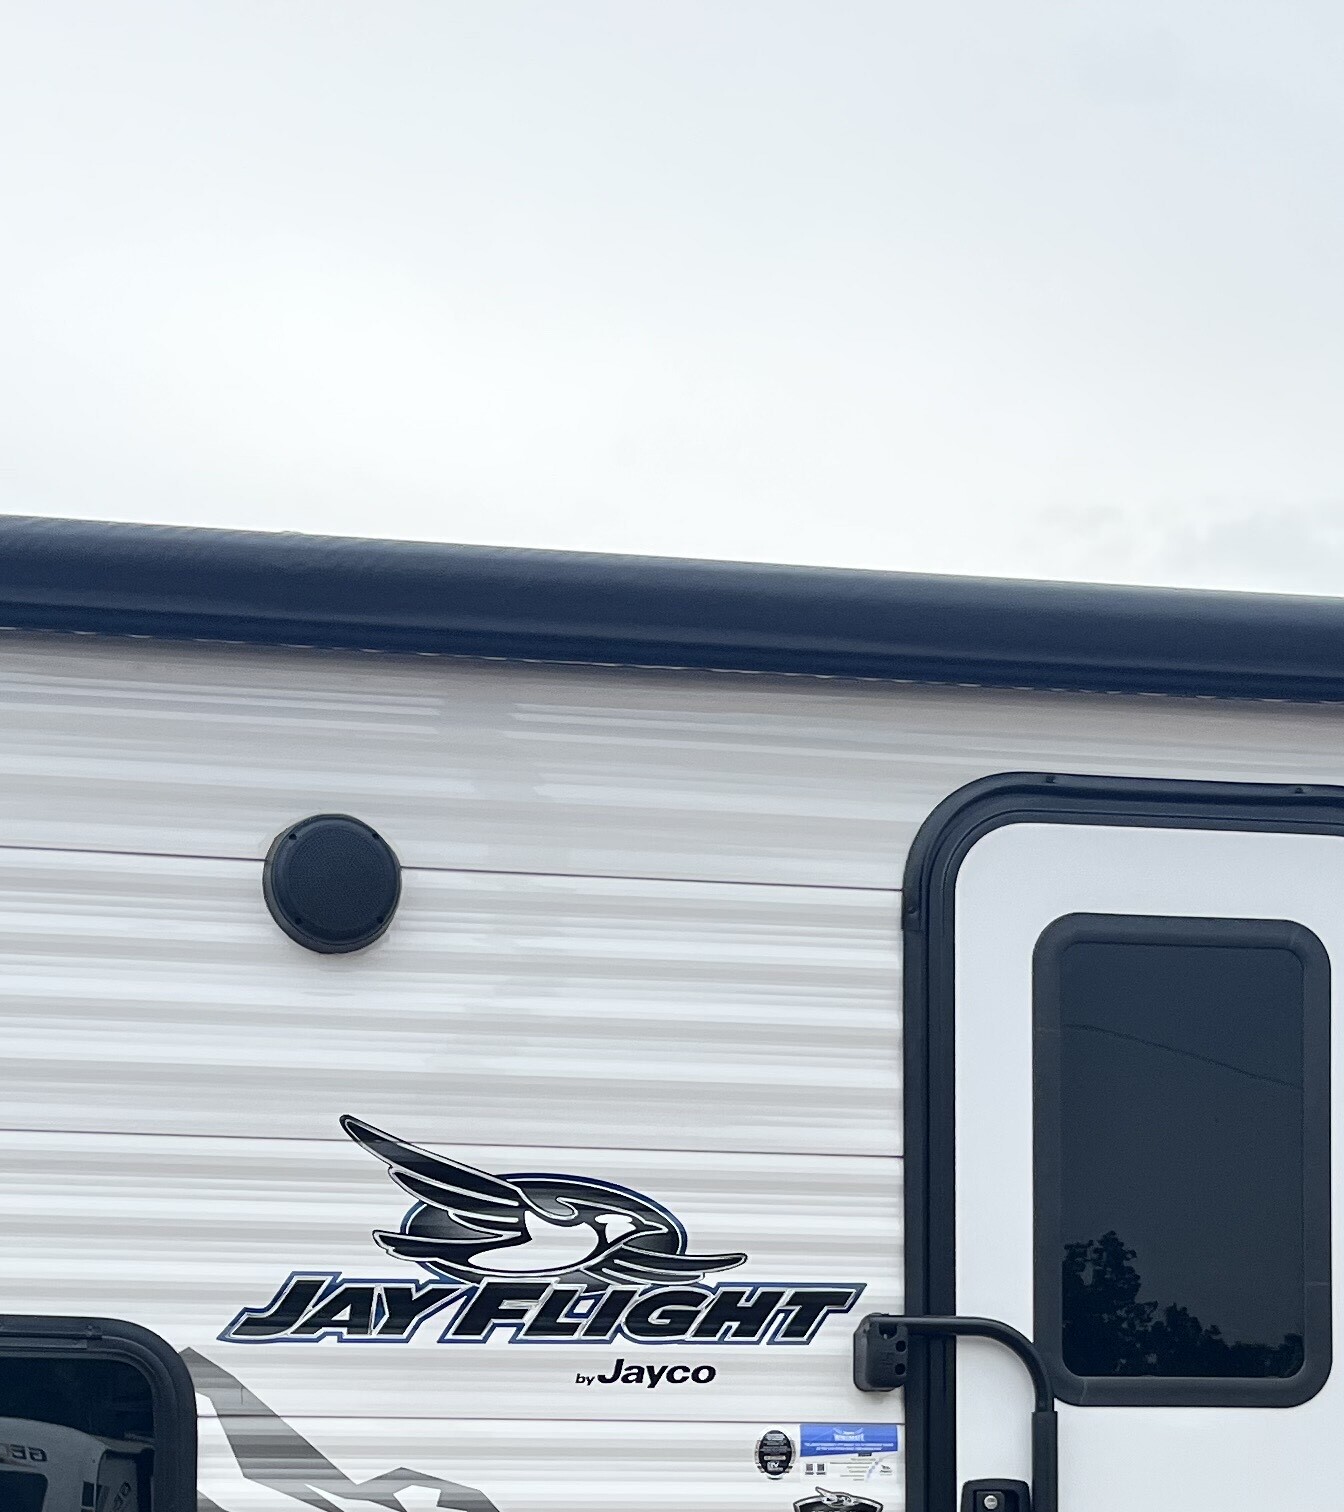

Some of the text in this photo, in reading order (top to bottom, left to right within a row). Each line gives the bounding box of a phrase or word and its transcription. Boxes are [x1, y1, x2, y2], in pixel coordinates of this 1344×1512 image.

[217, 1271, 865, 1346] JAY FLIGHT
[575, 1357, 716, 1388] by Jayco
